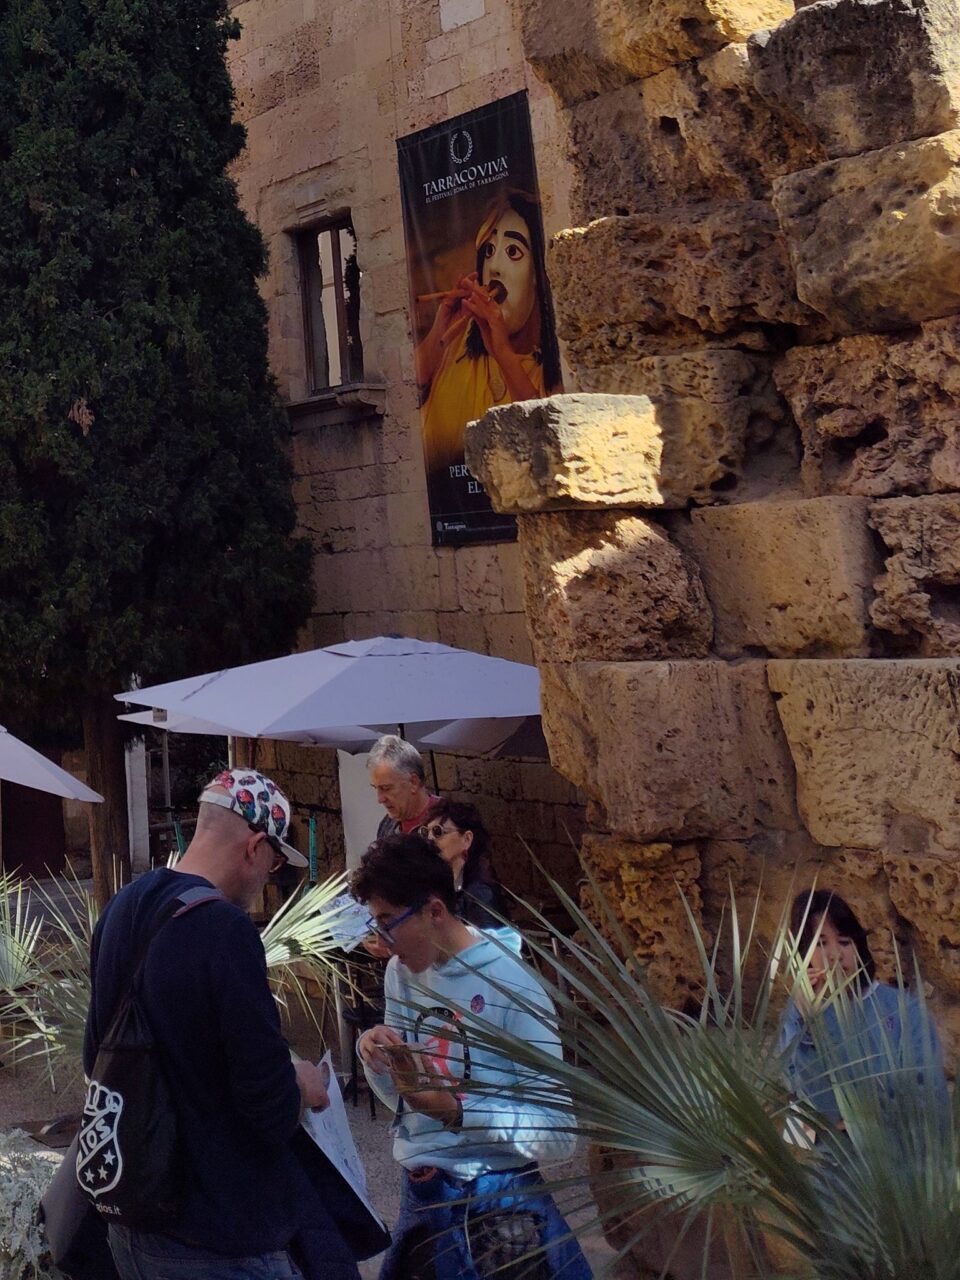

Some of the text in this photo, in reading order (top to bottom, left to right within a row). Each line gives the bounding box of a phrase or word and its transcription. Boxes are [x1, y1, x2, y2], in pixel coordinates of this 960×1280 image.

[431, 191, 453, 201] FESTIVAL
[468, 181, 475, 189] DE
[477, 171, 509, 186] TARRAGONA
[467, 481, 481, 494] EL
